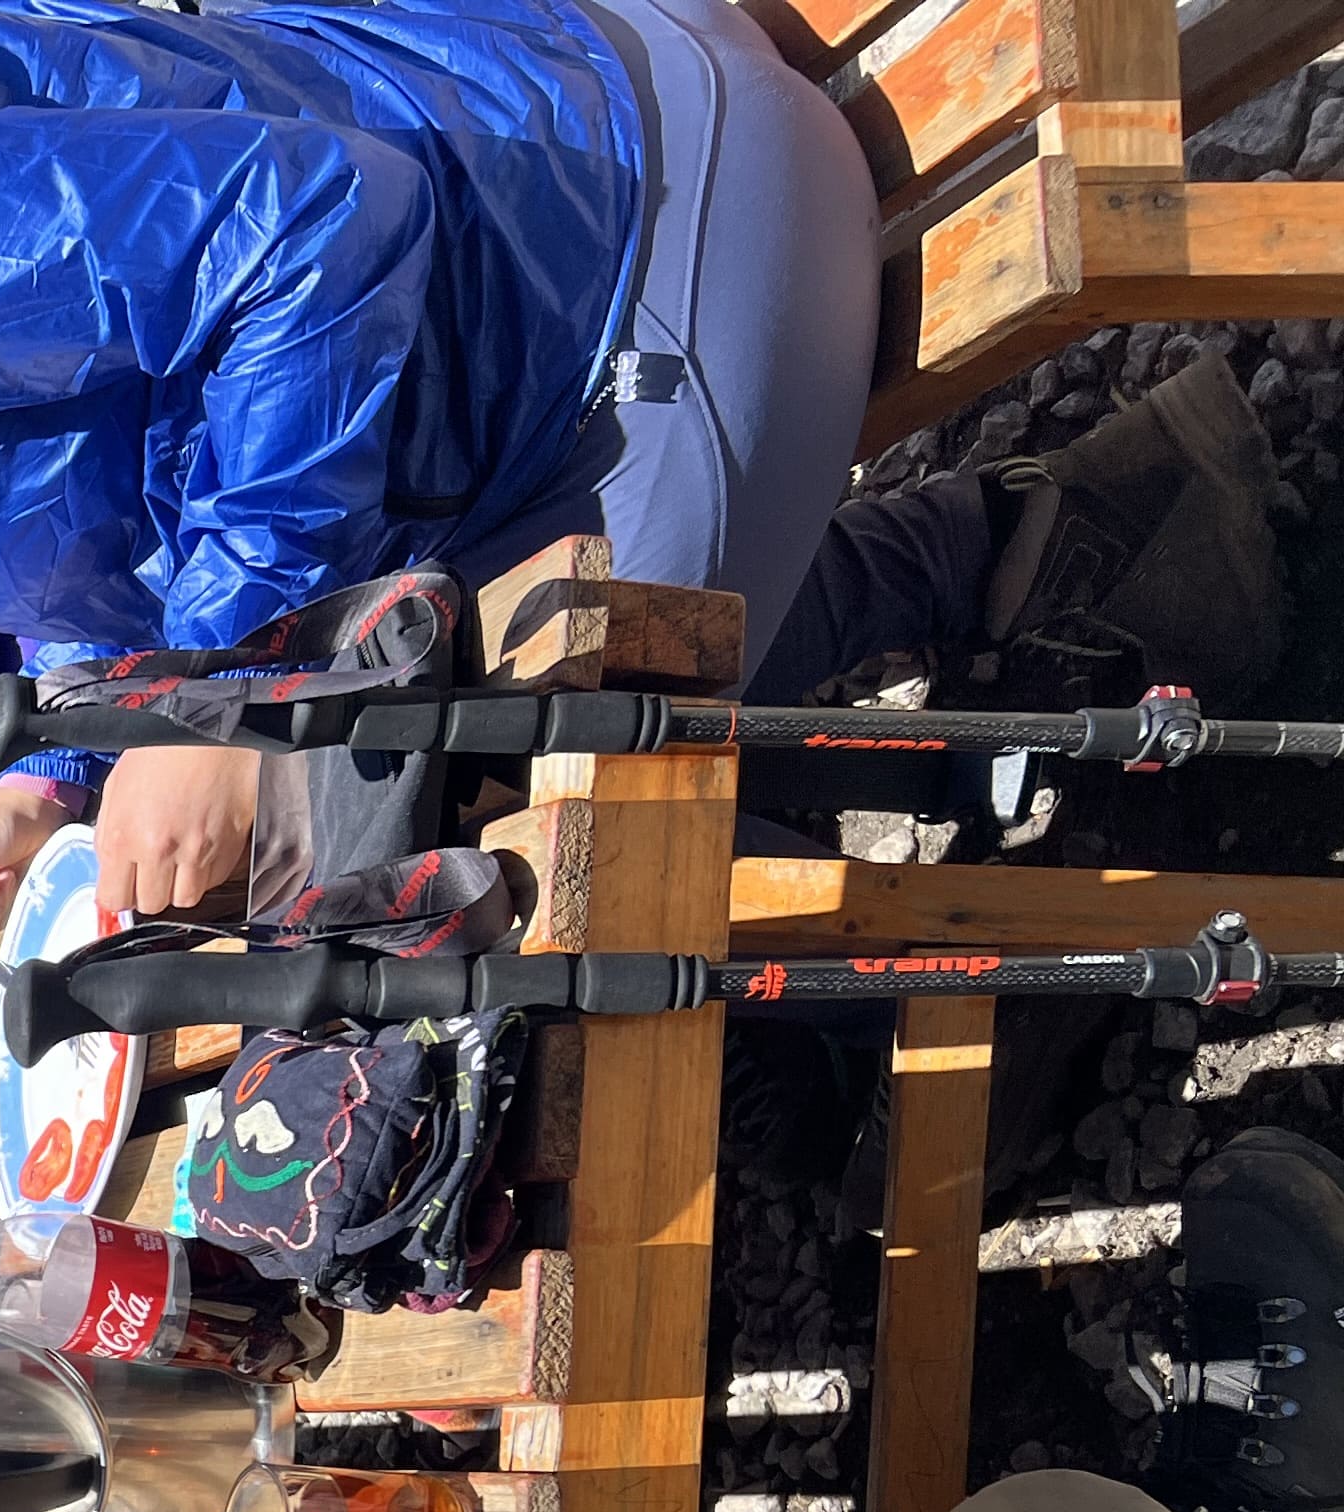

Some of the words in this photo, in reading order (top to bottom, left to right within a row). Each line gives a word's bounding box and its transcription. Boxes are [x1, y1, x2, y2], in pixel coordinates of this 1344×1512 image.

[385, 849, 442, 918] tramp
[845, 955, 1002, 976] tramp
[1062, 954, 1126, 966] CARBON
